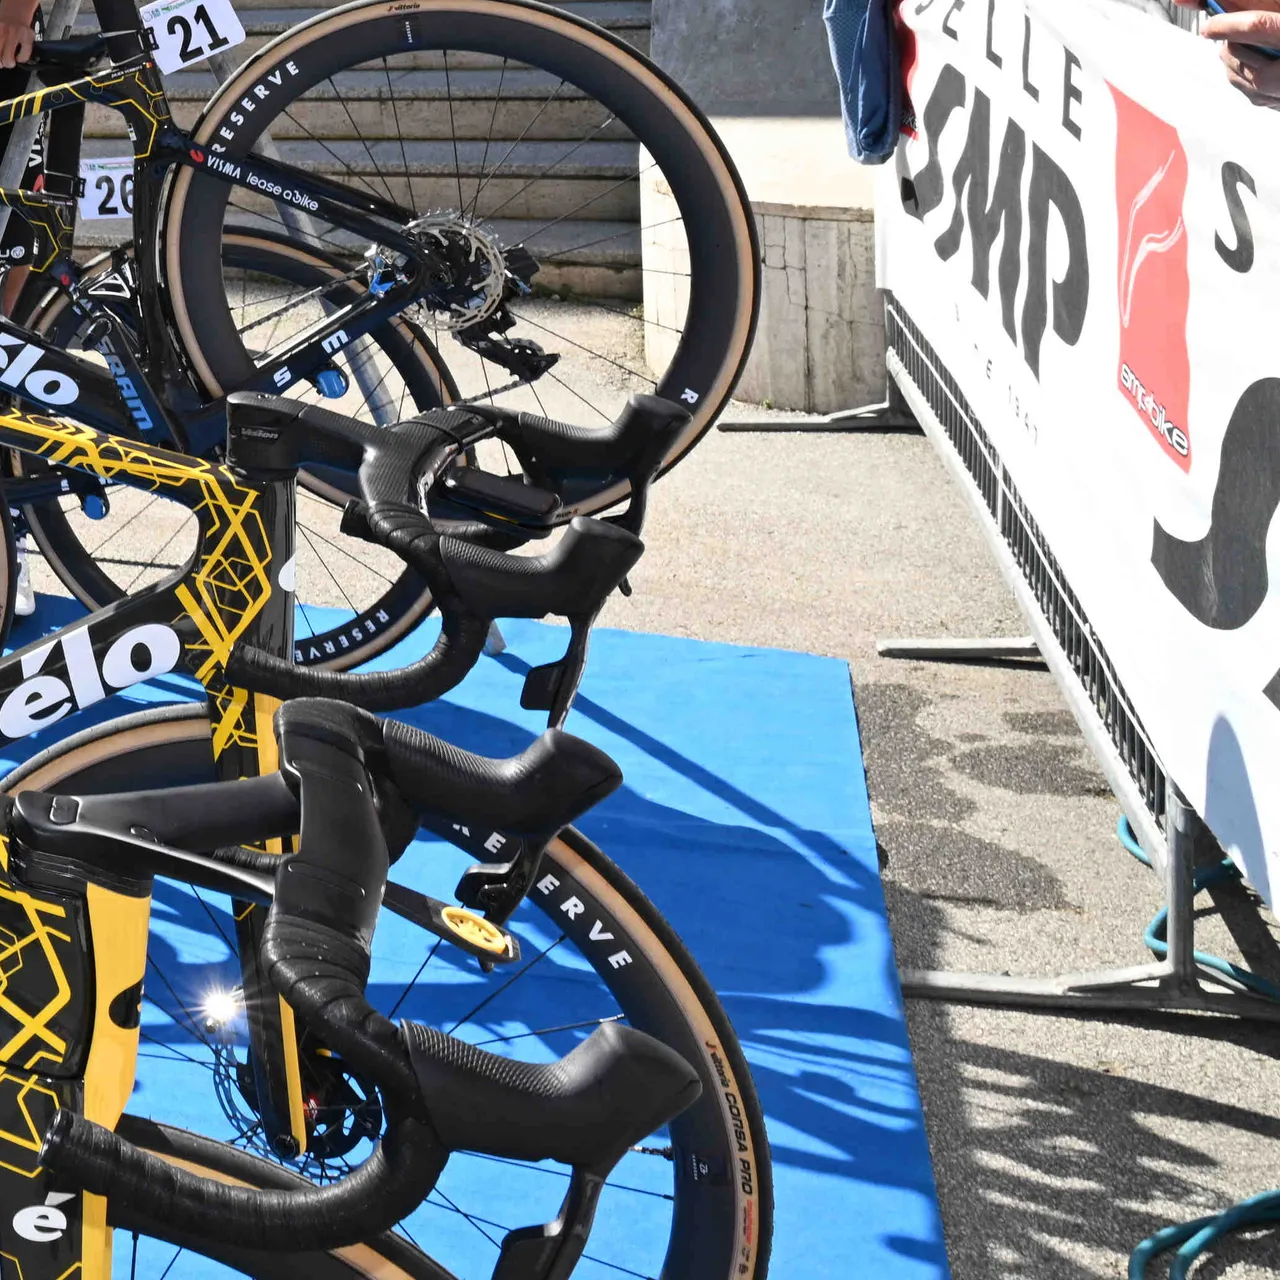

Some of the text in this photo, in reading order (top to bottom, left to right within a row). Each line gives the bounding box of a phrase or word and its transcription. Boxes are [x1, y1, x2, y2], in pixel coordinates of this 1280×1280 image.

[167, 3, 229, 63] 21
[211, 60, 299, 153] RESERVE
[95, 173, 134, 216] 26
[206, 154, 241, 180] VISMA
[247, 174, 282, 196] lease
[899, 62, 1090, 384] SMP
[294, 609, 390, 662] RESERVE
[725, 1092, 748, 1153] CORSA
[739, 1158, 753, 1196] PRO
